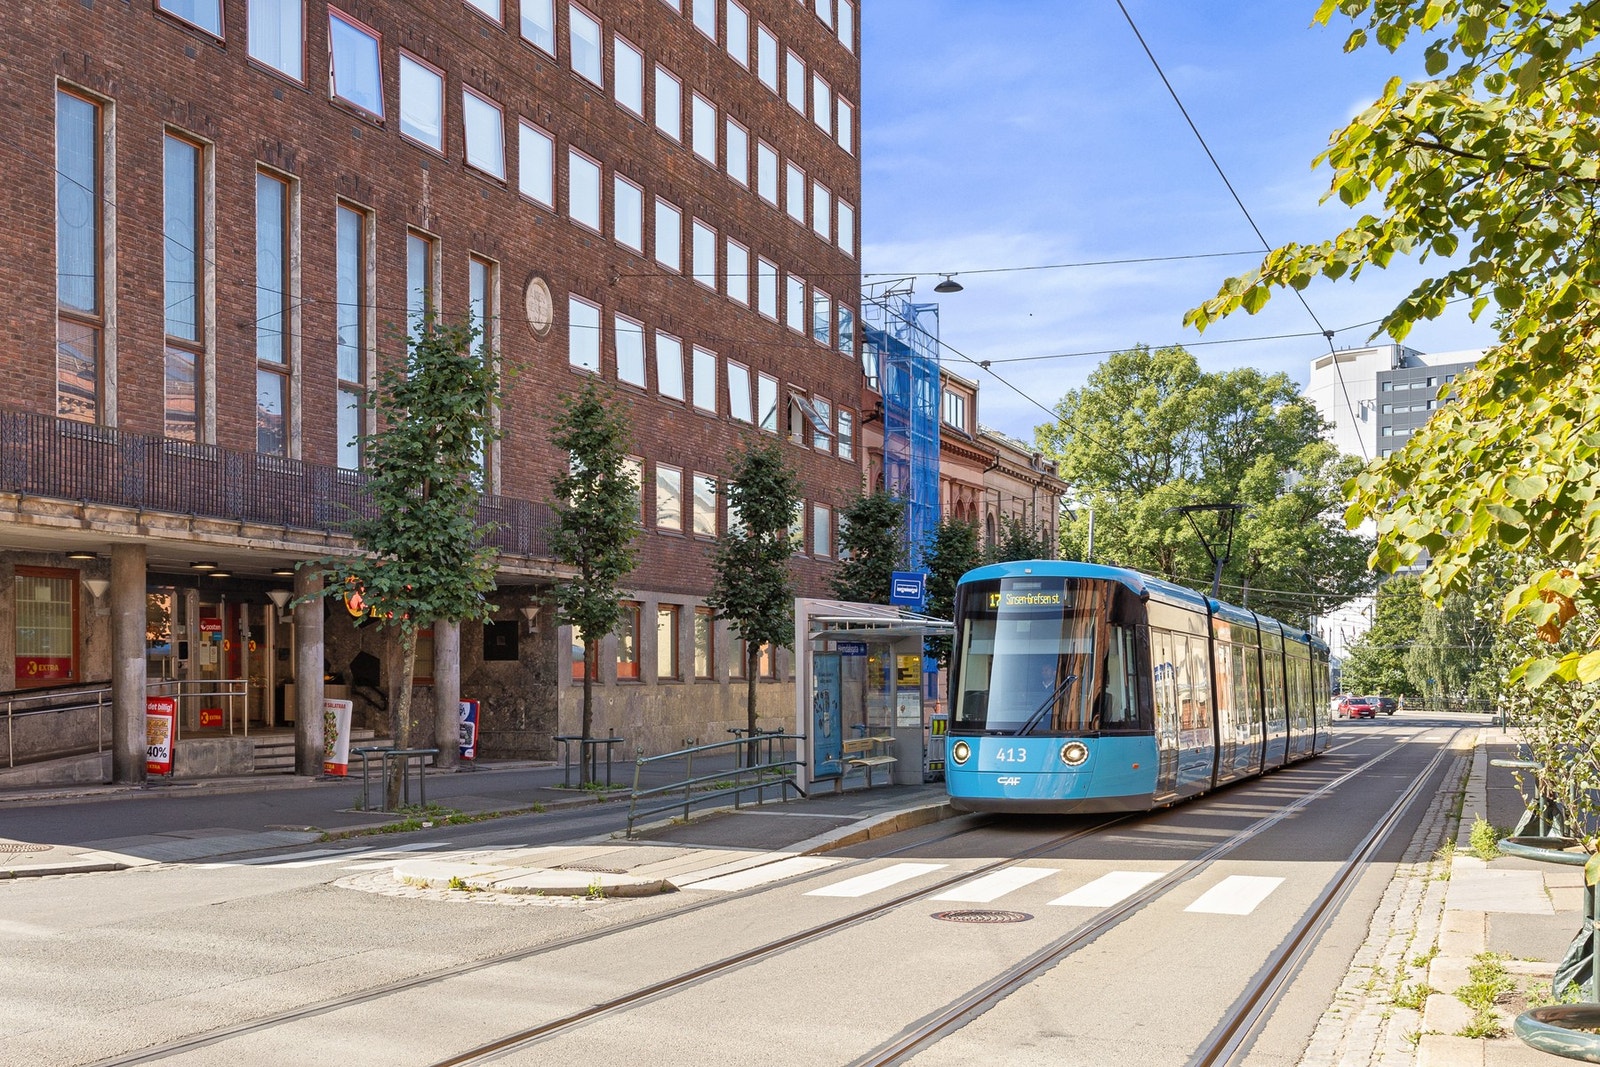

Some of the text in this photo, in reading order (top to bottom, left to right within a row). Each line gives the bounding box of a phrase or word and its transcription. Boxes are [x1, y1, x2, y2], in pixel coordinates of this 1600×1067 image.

[990, 593, 1002, 607] 17
[38, 664, 59, 672] EXTRA
[158, 703, 173, 712] billig!
[147, 746, 167, 758] 40%
[996, 747, 1027, 763] 413
[997, 776, 1022, 786] CAF
